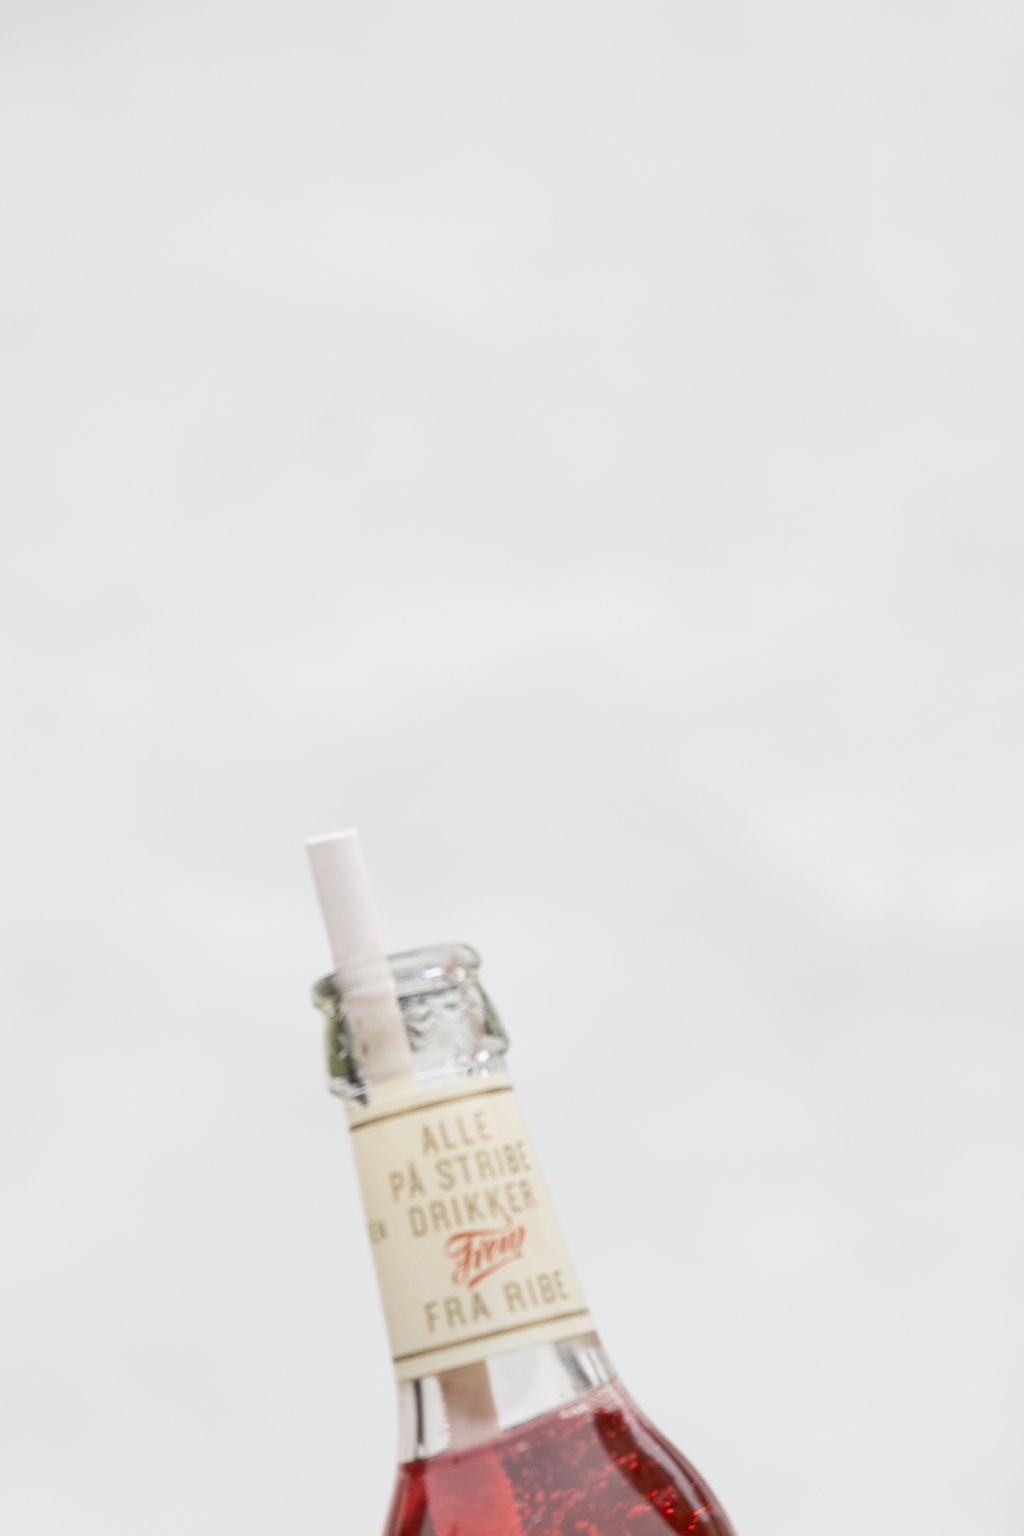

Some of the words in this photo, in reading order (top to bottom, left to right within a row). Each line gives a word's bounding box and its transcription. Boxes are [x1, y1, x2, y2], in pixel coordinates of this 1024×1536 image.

[423, 1111, 491, 1153] ALLE
[390, 1162, 425, 1203] PÅ
[437, 1142, 531, 1191] STRIBE
[408, 1179, 536, 1237] DRIKKER
[425, 1292, 491, 1332] FRA
[505, 1270, 570, 1311] RIBE
